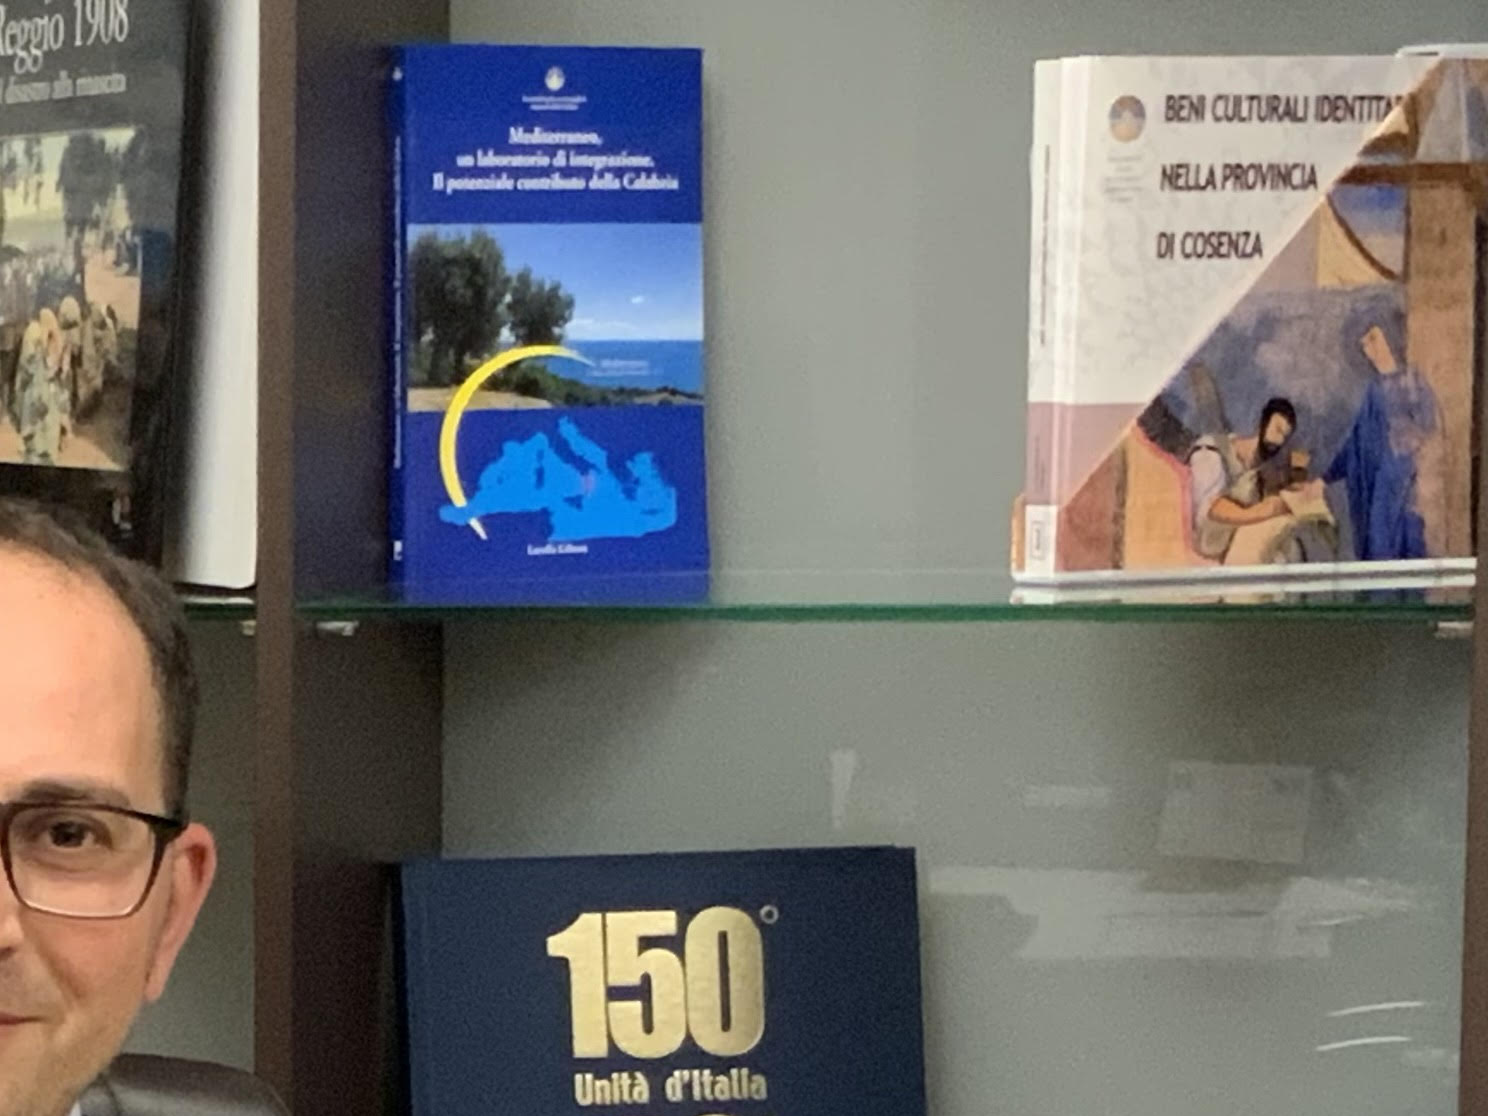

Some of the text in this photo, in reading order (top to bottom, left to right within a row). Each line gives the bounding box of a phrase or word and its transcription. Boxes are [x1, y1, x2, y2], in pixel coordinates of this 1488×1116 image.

[73, 0, 129, 47] 1908
[1164, 95, 1206, 123] BENI
[1212, 95, 1308, 123] CULTURALI
[1160, 163, 1217, 191] NELLA
[1221, 163, 1318, 190] PROVINCIA
[1157, 232, 1263, 259] DI COSENZA
[574, 1071, 650, 1106] Unità
